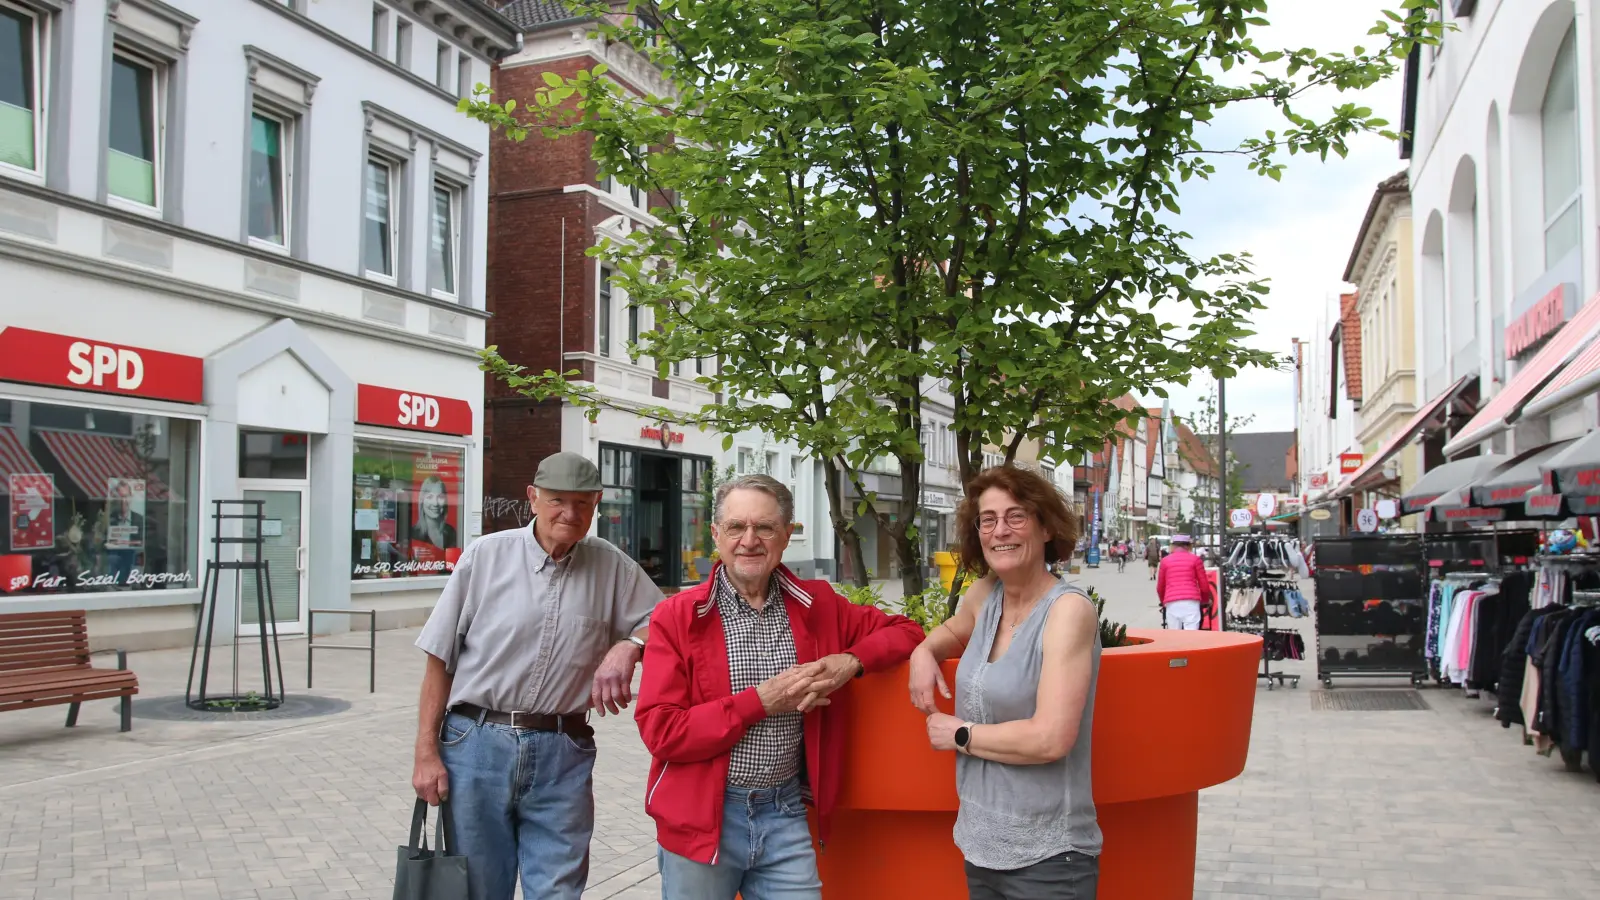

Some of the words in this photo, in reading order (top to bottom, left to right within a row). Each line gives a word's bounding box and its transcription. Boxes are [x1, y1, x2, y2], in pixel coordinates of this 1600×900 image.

[66, 341, 144, 390] SPD
[397, 392, 440, 428] SPD
[373, 561, 391, 572] SPD
[10, 575, 29, 590] SPD
[32, 572, 67, 588] Fair.
[76, 570, 120, 587] Sozial.
